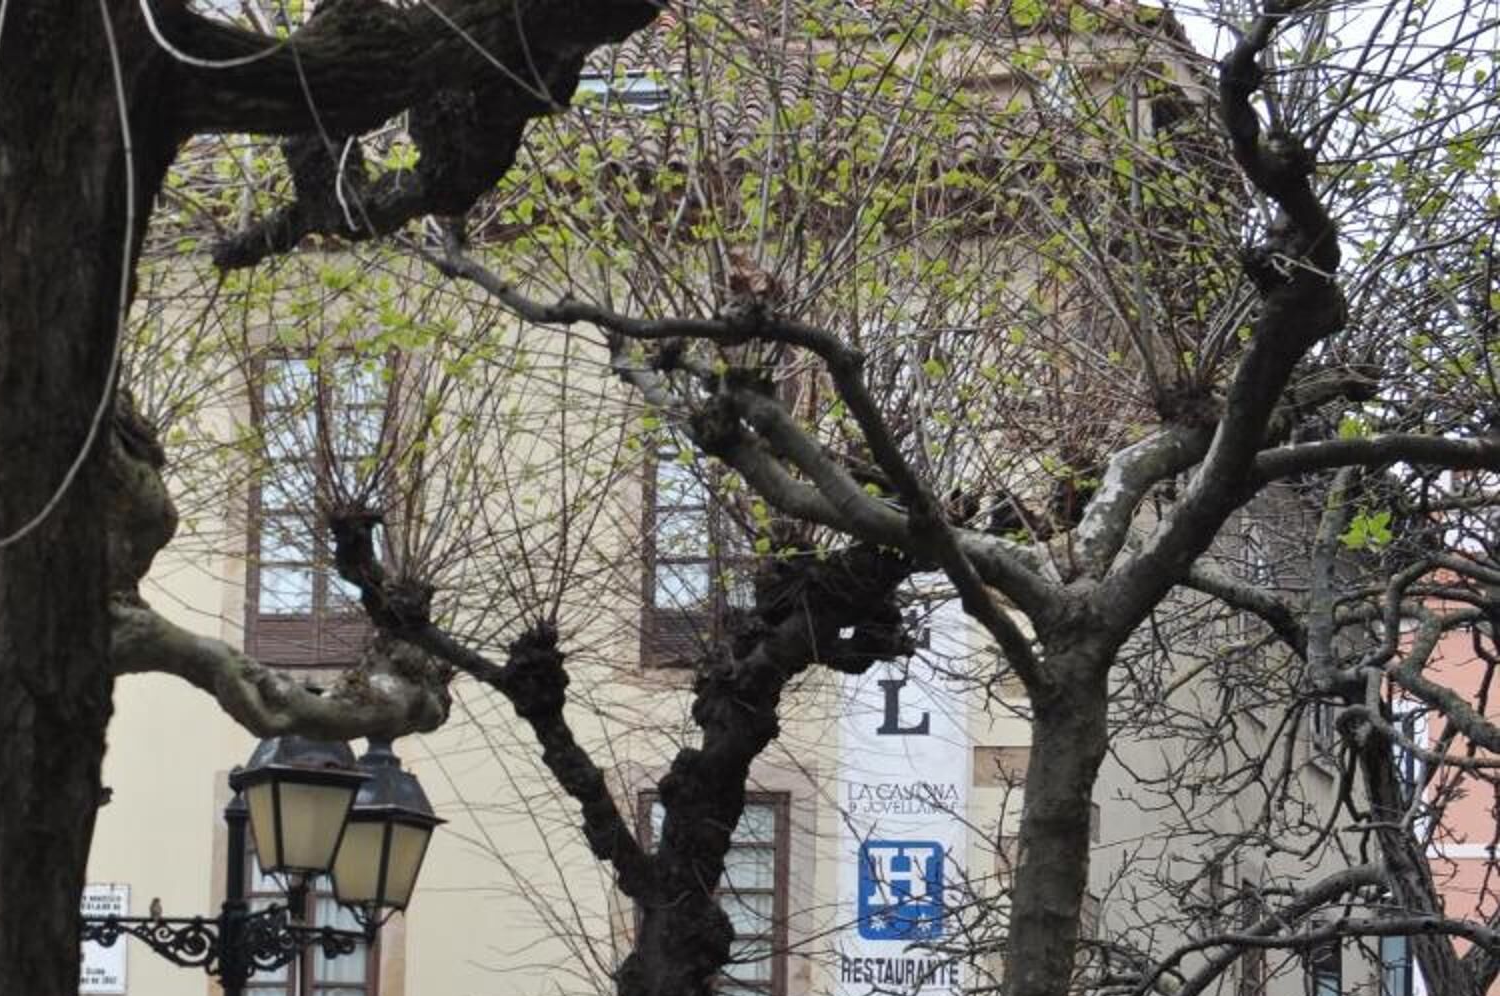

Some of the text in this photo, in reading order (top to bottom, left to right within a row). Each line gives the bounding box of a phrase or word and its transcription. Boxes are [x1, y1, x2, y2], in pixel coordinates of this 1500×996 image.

[848, 783, 959, 801] LA CASONA
[868, 847, 934, 905] H
[841, 957, 960, 985] RESTAURANTE
